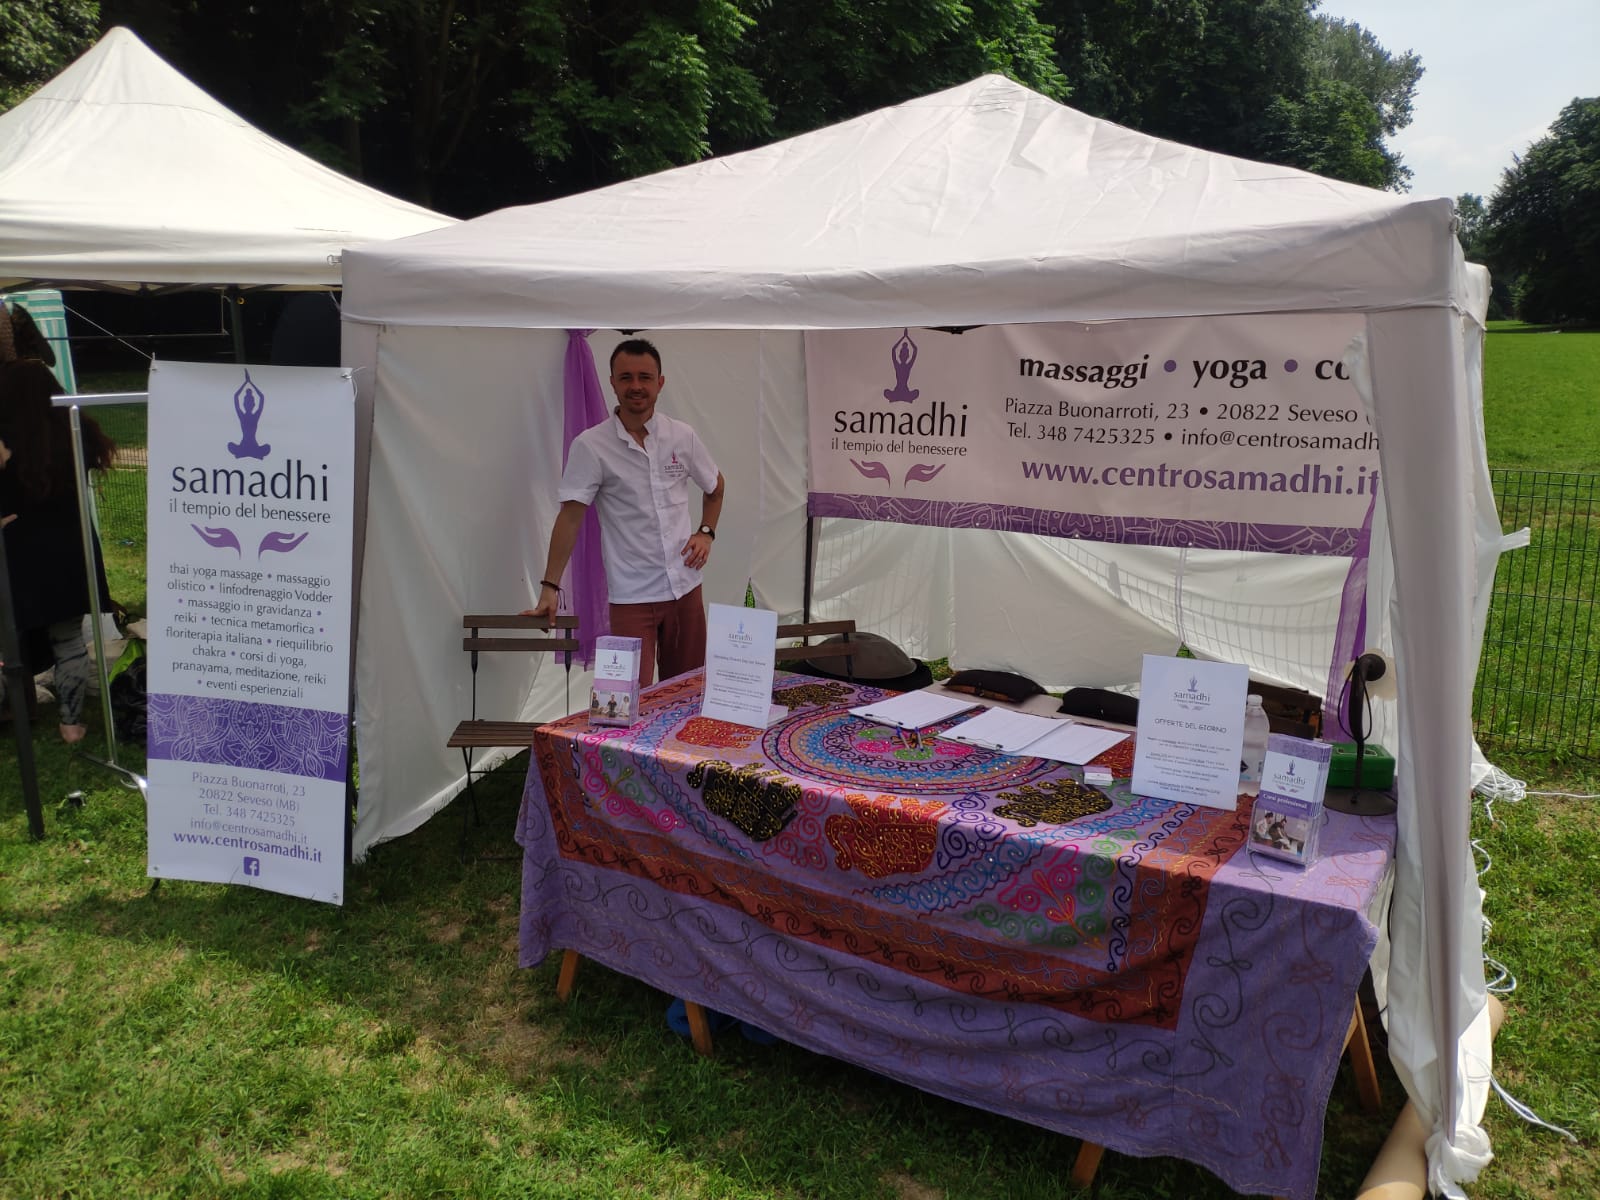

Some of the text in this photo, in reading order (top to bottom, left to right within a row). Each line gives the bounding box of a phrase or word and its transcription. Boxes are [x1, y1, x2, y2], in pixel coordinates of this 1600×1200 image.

[1019, 354, 1150, 389] massaggi
[1192, 359, 1268, 389] yoga
[834, 401, 968, 437] samadhi
[1005, 397, 1052, 416] Piazza
[1059, 401, 1159, 422] Buonarroti,
[1166, 403, 1190, 420] 23
[1216, 403, 1280, 421] 20822
[1287, 404, 1358, 423] Seveso
[831, 437, 967, 456] il tempio del benessere
[1007, 421, 1380, 450] Tel. 348 7425325 info@centrosamadh
[172, 459, 328, 501] samadhi
[1021, 461, 1380, 495] www.centrosamadhi.it
[169, 499, 331, 523] il tempio del benessere
[169, 563, 331, 588] thai yoga massage massaggio
[168, 579, 333, 603] olistico linfodrenaggio Vodder
[187, 598, 312, 617] massaggio in gravidanza
[174, 612, 315, 635] reiki tecnica metamorfica
[166, 626, 333, 653] floriterapia italiana riequilibrio
[192, 645, 307, 669] chakra corsi di yoga,
[172, 660, 327, 685] pranayama, meditazione, reiki
[206, 679, 303, 699] eventi esperienziali
[1173, 690, 1210, 703] samadhi
[1154, 717, 1228, 735] OFFERTE DEL GIORNO
[192, 771, 306, 797] Piazza Buonarroti, 23
[199, 788, 300, 813] 20822 Seveso (MB)
[203, 803, 295, 828] Tel. 348 7425325
[190, 817, 308, 844] info@centrosamadhi.it
[173, 831, 322, 864] www.centrosamadhi.it
